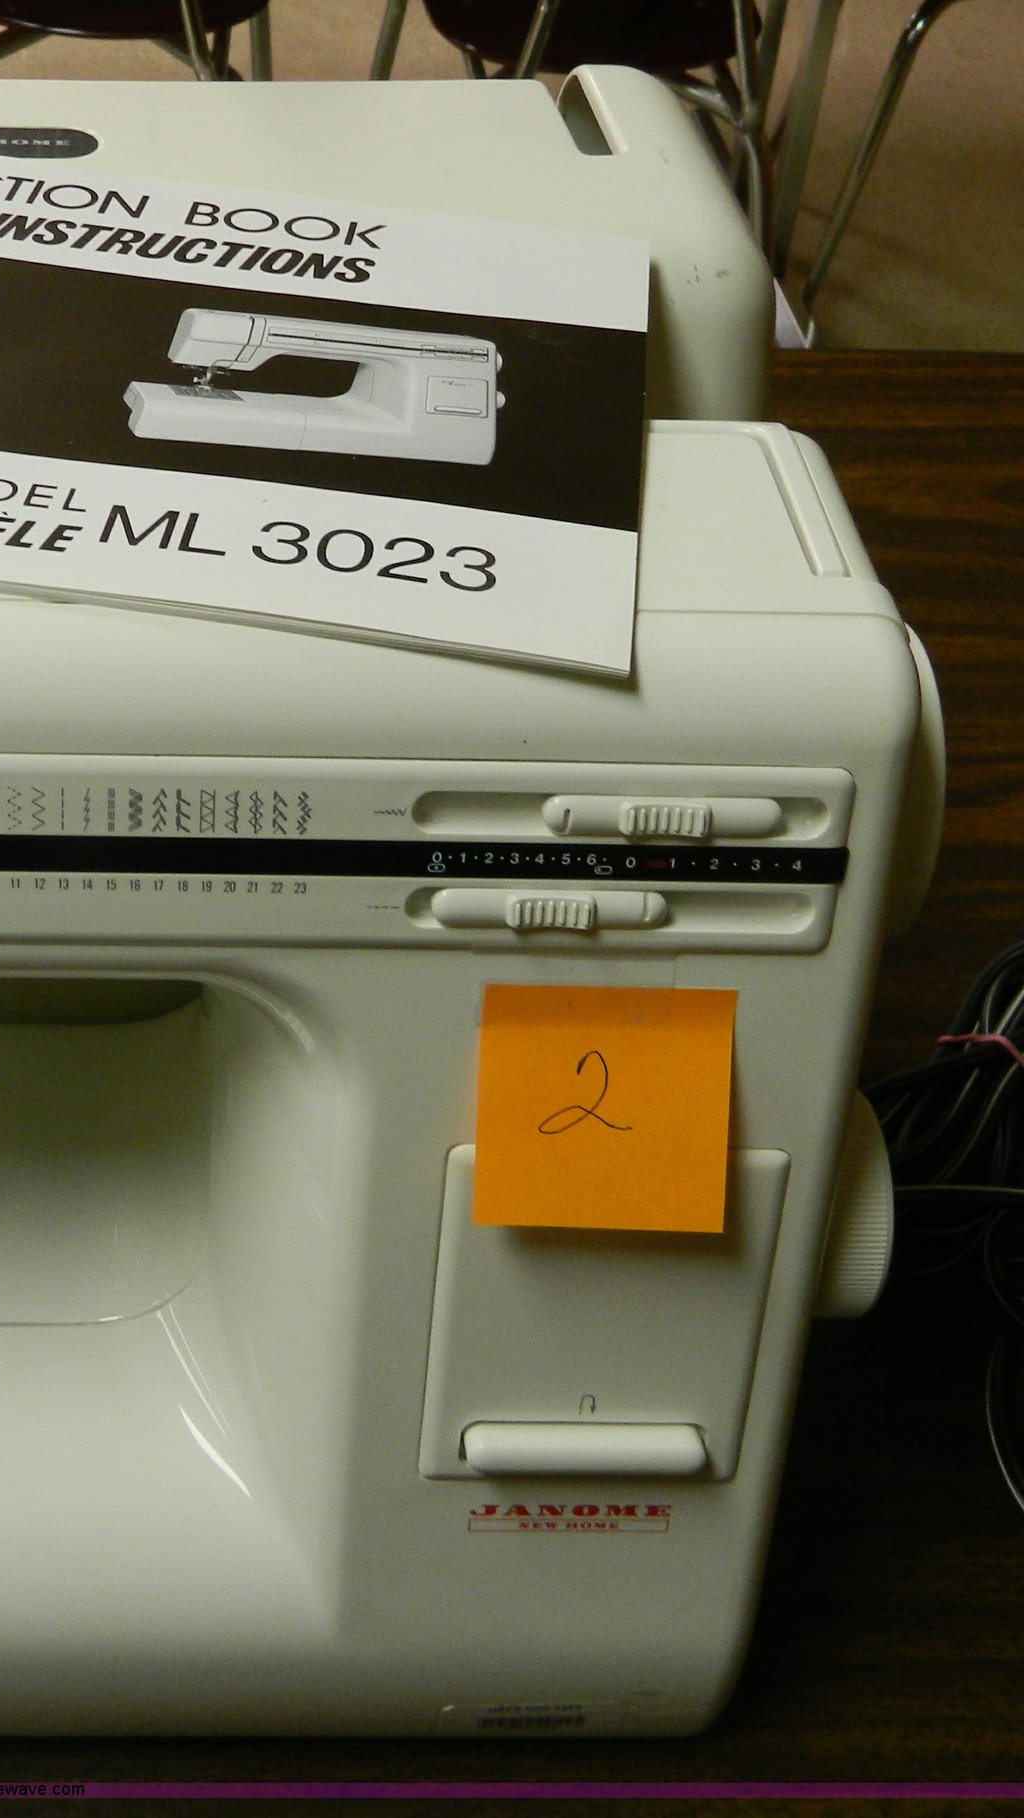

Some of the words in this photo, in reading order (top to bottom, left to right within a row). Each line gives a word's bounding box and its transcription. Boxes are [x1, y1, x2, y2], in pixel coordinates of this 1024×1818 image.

[183, 201, 389, 249] BOOK
[98, 504, 226, 556] ML
[251, 520, 497, 592] 3023
[432, 851, 442, 863] 0
[460, 853, 466, 863] 1
[484, 852, 494, 864] 2
[510, 853, 520, 864] 3
[535, 853, 544, 864] 4
[561, 853, 571, 865] 5
[587, 854, 597, 865] 6
[626, 857, 636, 868] 0
[669, 858, 676, 869] 1
[709, 858, 719, 870] 2
[751, 859, 761, 871] 3
[792, 860, 802, 871] 4
[11, 879, 20, 889] 11
[35, 879, 45, 890] 12
[59, 879, 69, 890] 13
[82, 880, 92, 890] 14
[106, 880, 117, 890] 15
[130, 880, 140, 891] 16
[153, 880, 164, 891] 17
[178, 880, 188, 892] 18
[201, 881, 212, 892] 19
[224, 881, 236, 892] 20
[247, 882, 258, 892] 21
[271, 882, 283, 893] 22
[294, 882, 306, 893] 23
[538, 1050, 632, 1134] 2
[470, 1504, 672, 1518] JANOME
[518, 1521, 556, 1530] NEW
[565, 1521, 620, 1530] HOME
